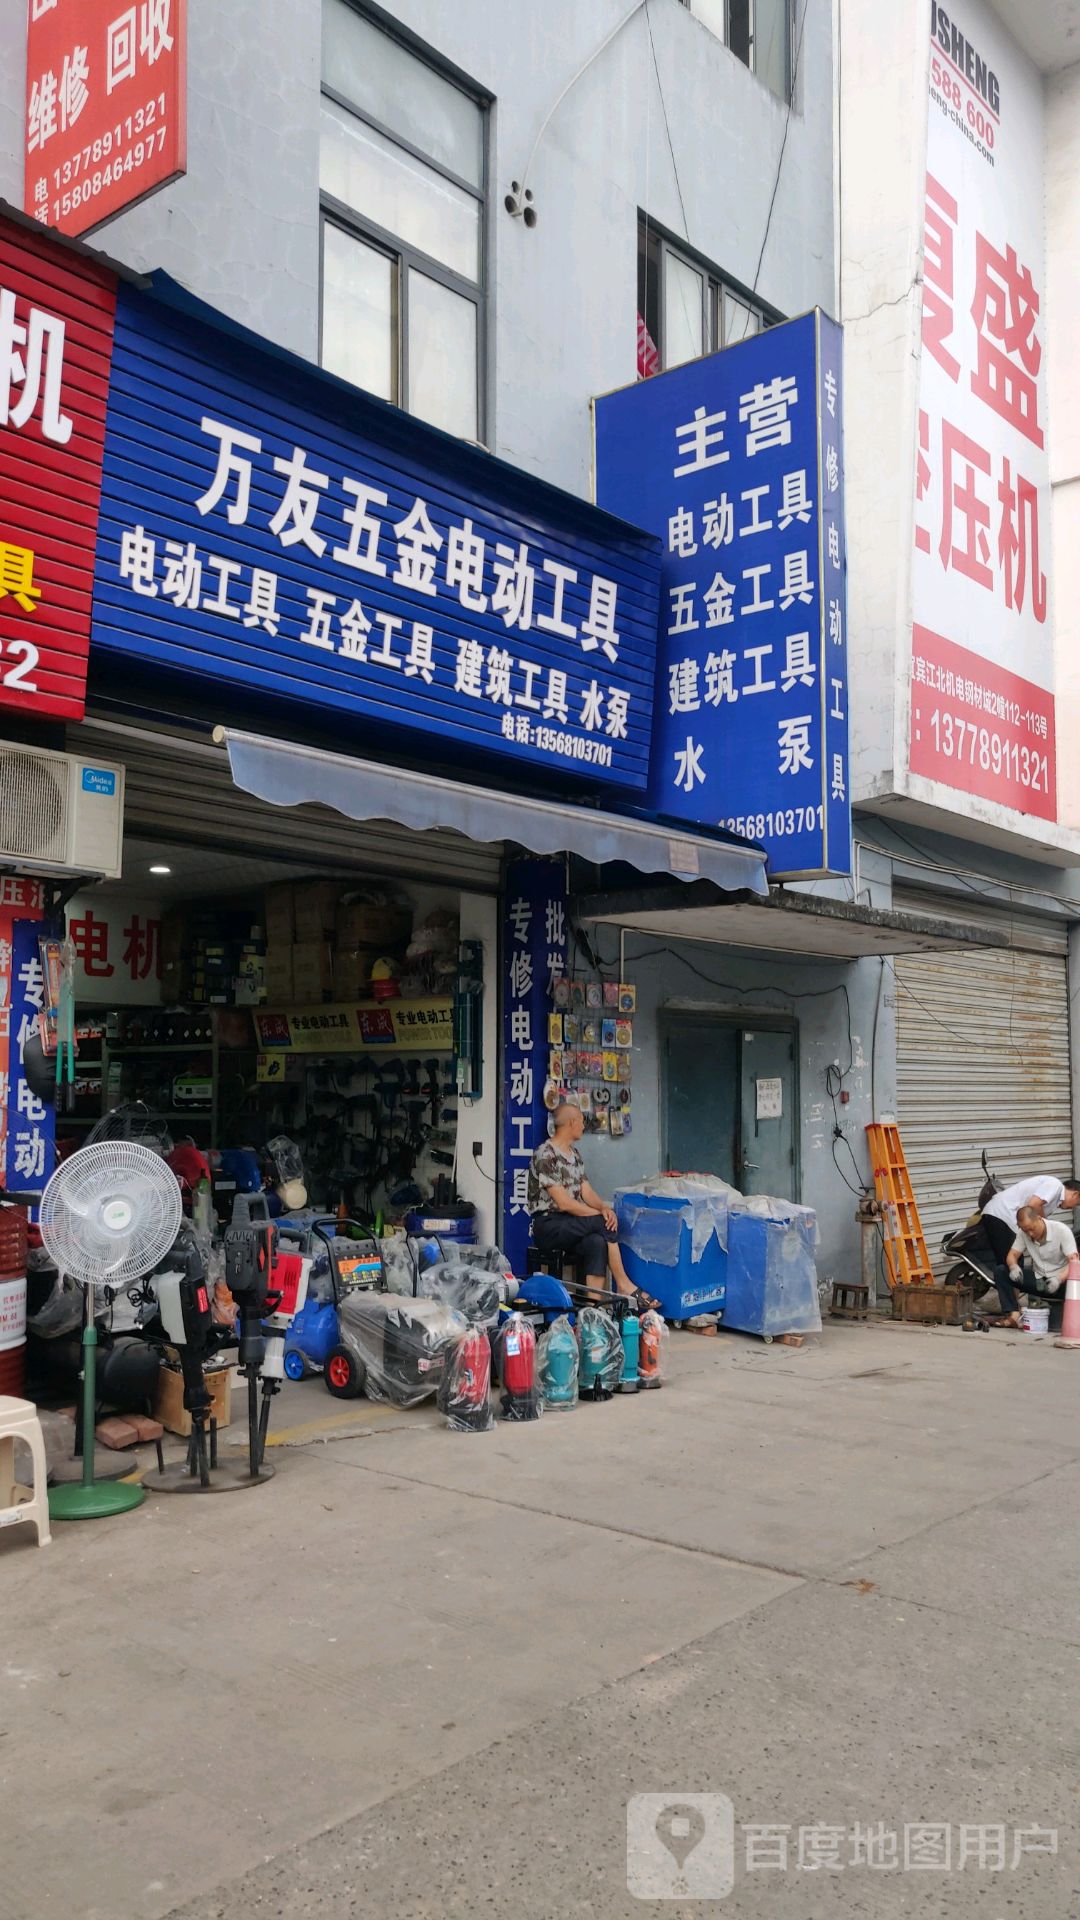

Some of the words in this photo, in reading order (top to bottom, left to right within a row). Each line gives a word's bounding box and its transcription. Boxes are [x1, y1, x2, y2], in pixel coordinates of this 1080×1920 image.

[28, 46, 90, 154] 维修
[106, 0, 174, 96] 回收
[932, 57, 962, 111] 588
[966, 100, 995, 149] 600
[53, 92, 166, 190] 13778911321
[53, 126, 167, 222] 15808464977
[0, 289, 73, 445] 机
[673, 375, 799, 478] 主营
[195, 416, 621, 664] 万友五金电动工具
[667, 469, 813, 560] 电动工具
[915, 408, 1048, 625] 压机
[119, 525, 281, 637] 电动工具
[300, 587, 437, 685] 五金工具
[453, 637, 570, 726] 建筑工具
[579, 680, 632, 741] 水泵
[667, 549, 815, 636] 五金工具
[824, 369, 847, 804] 专修电动工具
[0, 639, 39, 693] 2
[667, 630, 817, 716] 建筑工具
[501, 711, 613, 768] 电话:13568103701
[69, 910, 162, 981] 电机
[510, 897, 534, 1217] 专修电动工具
